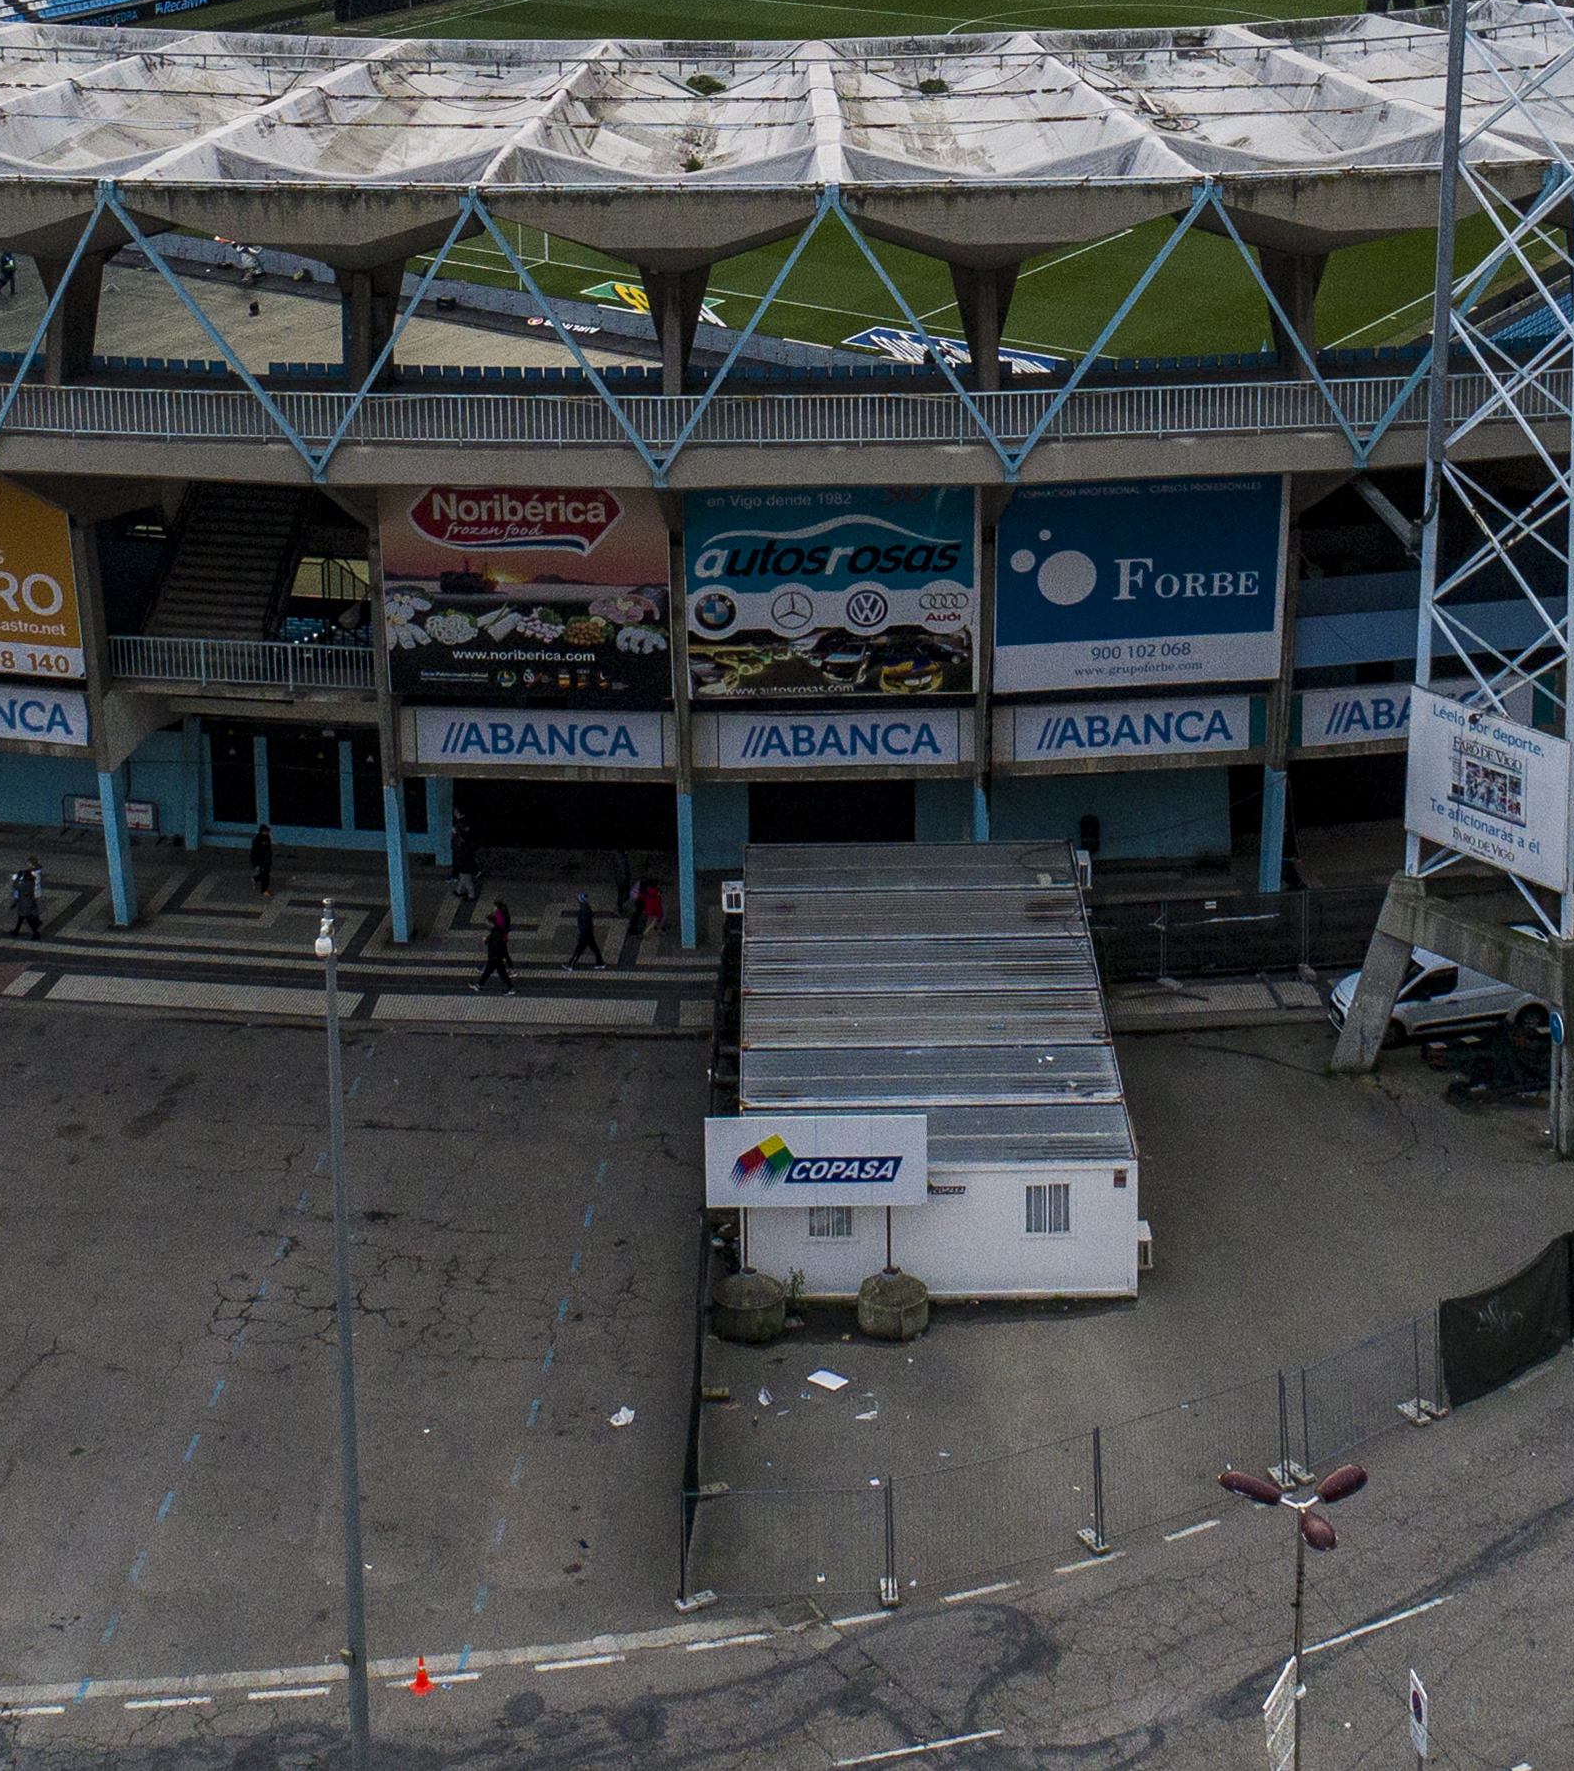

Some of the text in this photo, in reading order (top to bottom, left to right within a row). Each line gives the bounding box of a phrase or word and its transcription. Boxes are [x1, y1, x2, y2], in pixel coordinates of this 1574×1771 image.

[433, 491, 607, 525] Noribérica
[729, 494, 762, 510] Vigo
[816, 492, 853, 506] 1982
[443, 522, 544, 541] frozen food
[1112, 557, 1260, 601] FORBE
[926, 611, 962, 624] Audi
[452, 650, 596, 662] www.noriberica.com
[1091, 640, 1191, 661] 900 102 068
[28, 652, 71, 674] 140
[1074, 658, 1203, 678] www.grupoforbe.com
[1433, 703, 1466, 727] Léelo
[1492, 727, 1545, 757] deporte.
[1453, 736, 1523, 770] FARO DE VIGO
[1430, 798, 1445, 815] Te
[1448, 804, 1514, 844] aficionarás
[1529, 838, 1541, 855] él
[1452, 827, 1476, 846] FARO
[1491, 842, 1516, 862] VIGO
[790, 1159, 897, 1182] COPASA
[931, 1185, 966, 1196] COPASA
